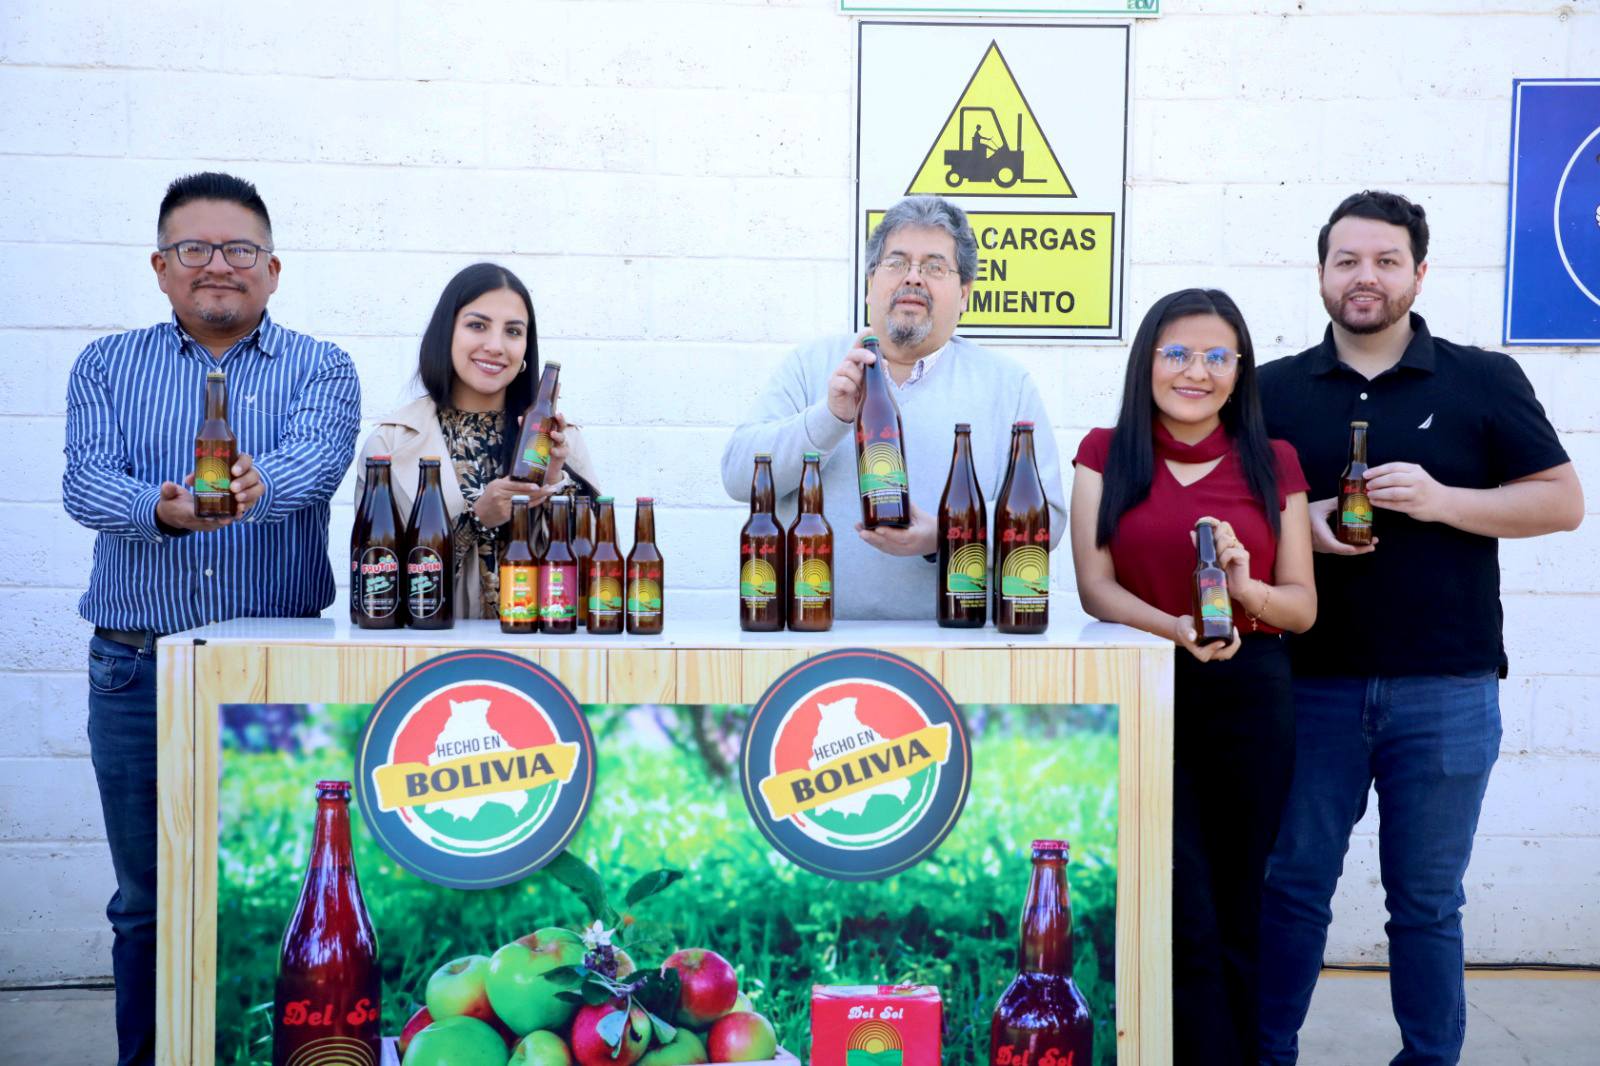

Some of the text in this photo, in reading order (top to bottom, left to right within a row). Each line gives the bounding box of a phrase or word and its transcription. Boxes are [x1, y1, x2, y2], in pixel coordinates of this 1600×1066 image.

[970, 227, 1096, 251] CARGAS
[966, 291, 1075, 313] MIENTO
[436, 735, 501, 758] HECHO EN
[814, 729, 875, 761] HECHO EN
[405, 752, 555, 798] BOLIVIA
[790, 738, 931, 804] BOLIVIA
[283, 999, 334, 1026] Del
[847, 1005, 904, 1019] Del Sol
[996, 1045, 1074, 1066] Del Sol
